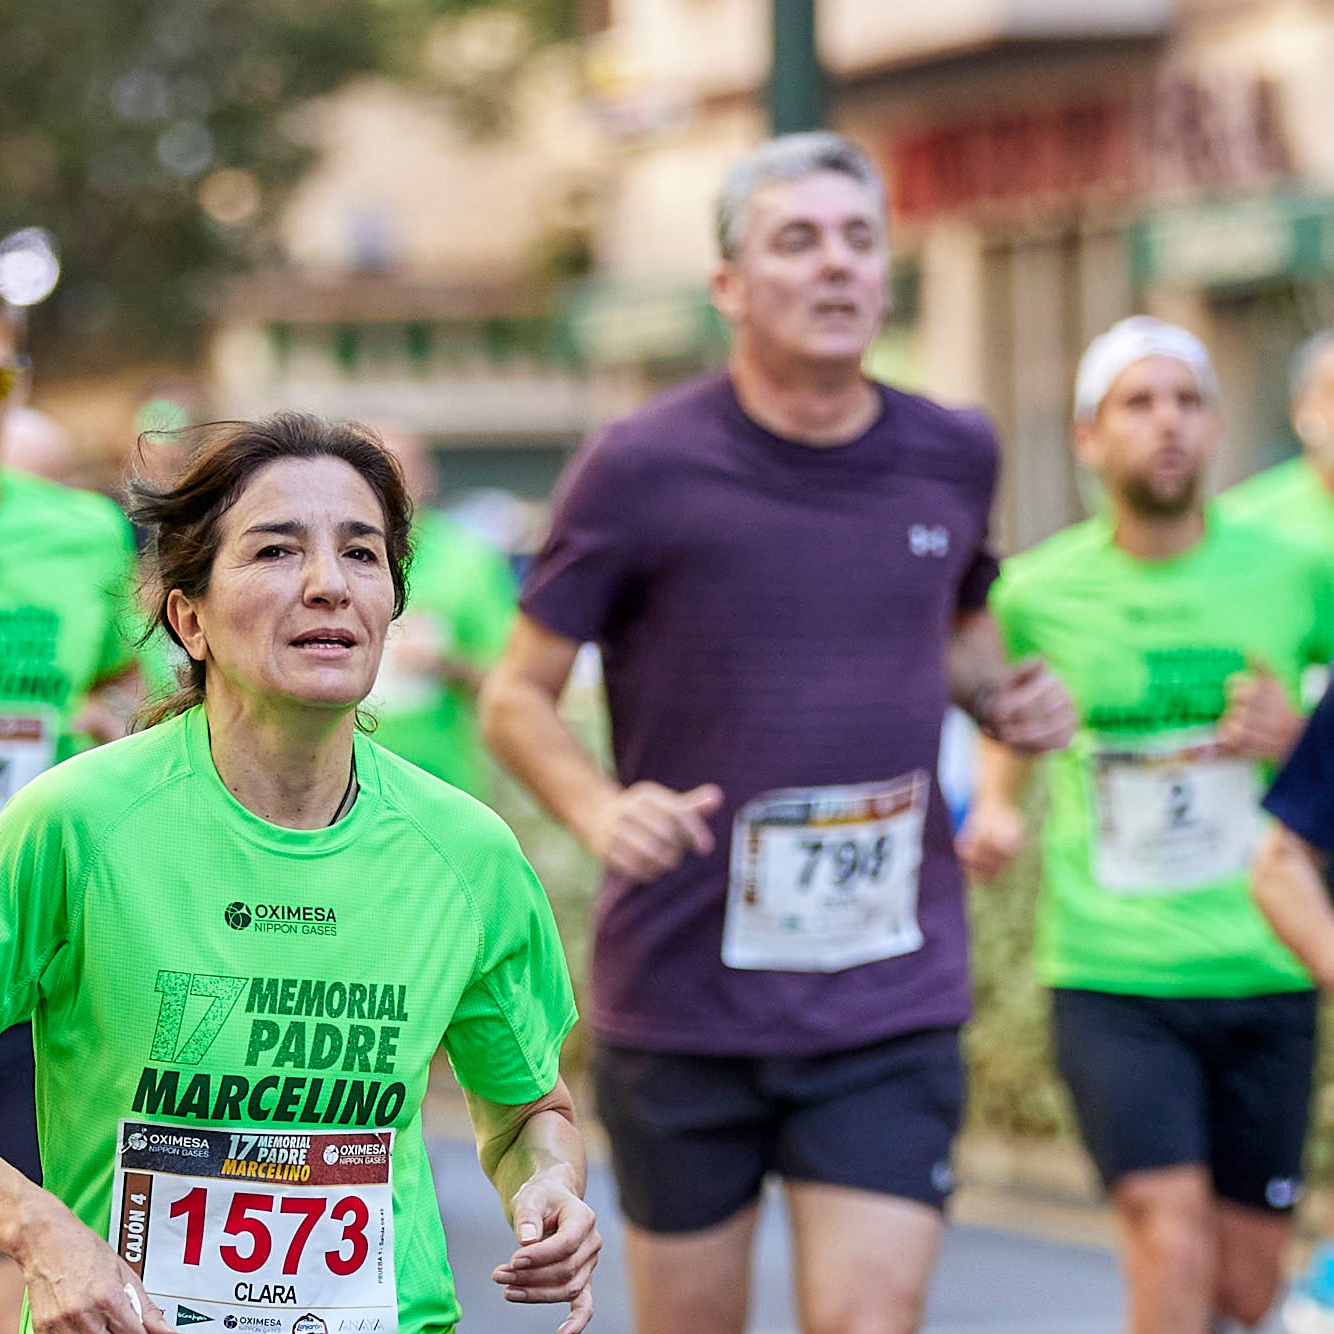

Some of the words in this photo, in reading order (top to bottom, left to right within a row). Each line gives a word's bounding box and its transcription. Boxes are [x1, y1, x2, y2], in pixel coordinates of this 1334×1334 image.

[255, 904, 337, 923] OXIMESA
[254, 922, 298, 935] NIPPON
[302, 924, 337, 936] GASES
[245, 977, 408, 1022] MEMORIAL
[149, 970, 249, 1066] 17
[244, 1019, 401, 1075] PADRE
[131, 1067, 406, 1127] MARCELINO
[149, 1134, 210, 1149] OXIMESA
[227, 1134, 260, 1160] 17
[257, 1135, 311, 1149] MEMORIAL
[340, 1144, 386, 1156] OXIMESA
[148, 1145, 180, 1155] NIPPON
[182, 1149, 210, 1158] GASES
[257, 1147, 308, 1165] PADRE
[339, 1156, 365, 1165] NIPPON
[365, 1156, 386, 1165] GASES
[221, 1159, 311, 1182] MARCELINO
[130, 1193, 147, 1206] 4
[123, 1209, 146, 1263] CAJÓN
[170, 1187, 369, 1276] 1573
[234, 1282, 297, 1304] CLARA
[240, 1316, 282, 1327] OXIMESA
